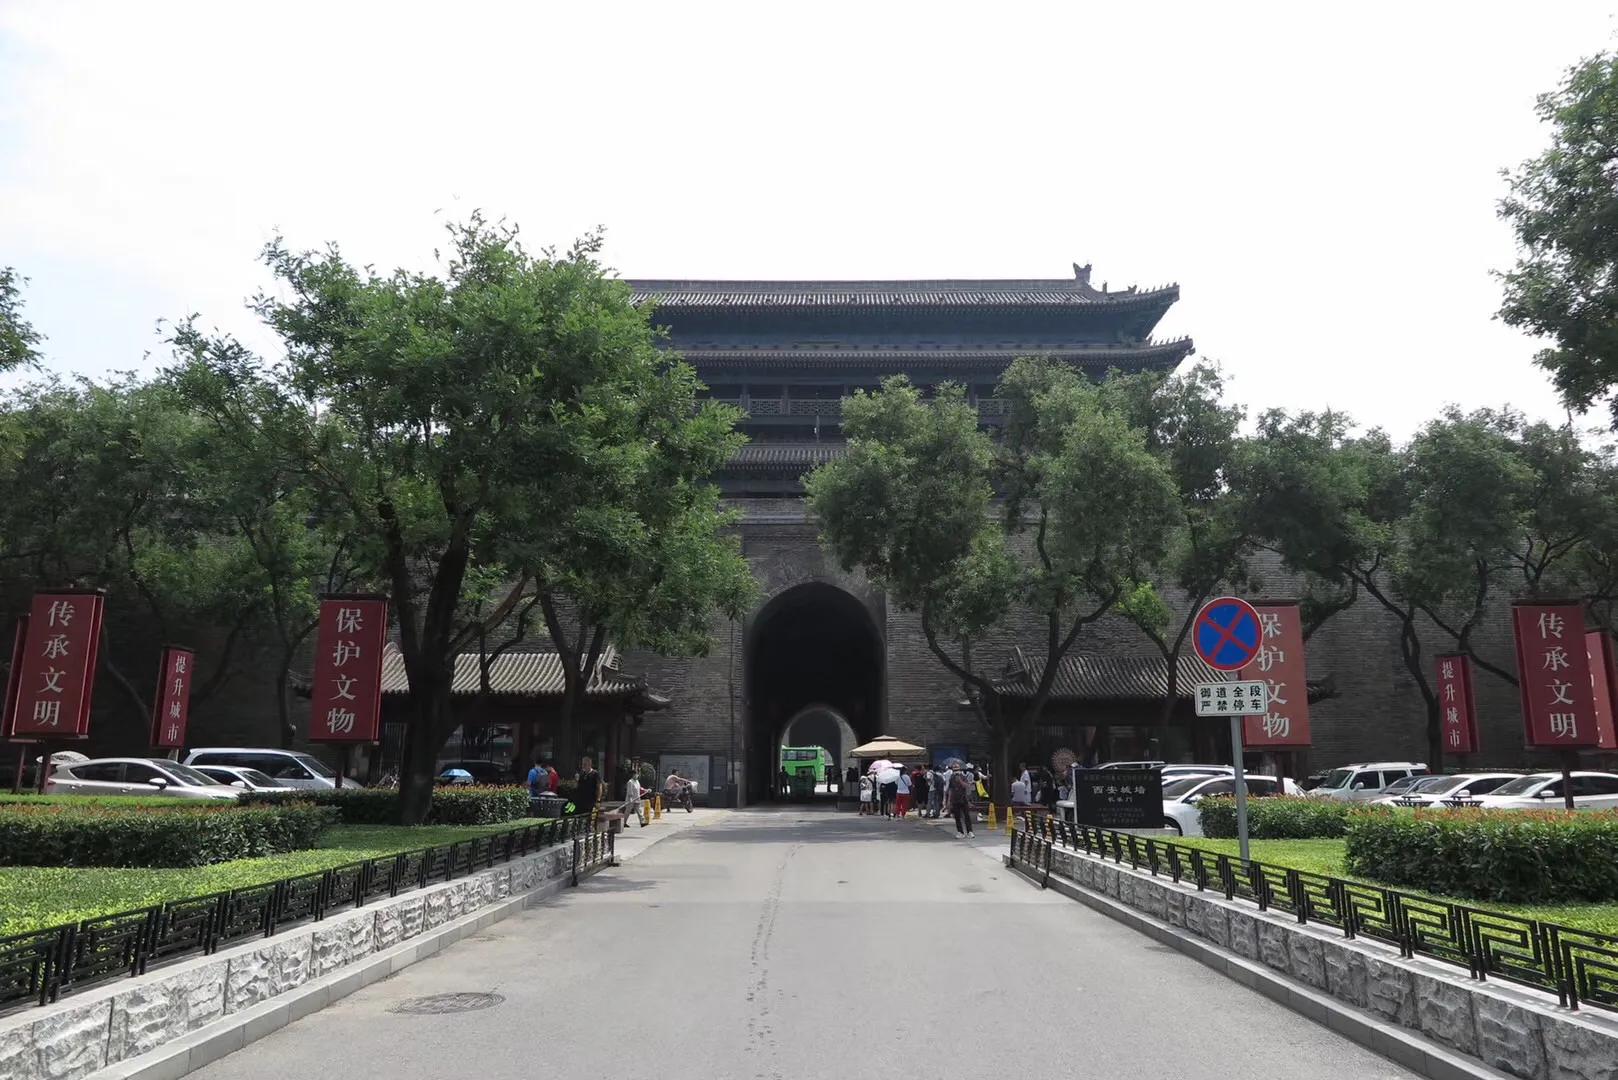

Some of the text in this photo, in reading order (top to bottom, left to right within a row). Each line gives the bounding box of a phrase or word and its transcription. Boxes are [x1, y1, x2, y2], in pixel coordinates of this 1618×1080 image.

[32, 600, 76, 727] 传承文明
[167, 654, 187, 743] 提升城市
[326, 607, 364, 734] 保护文物
[1200, 685, 1262, 699] 御道全段
[1200, 698, 1262, 712] 严禁停车
[1442, 661, 1460, 747] 提升城市
[1537, 612, 1577, 739] 传承文明
[1091, 785, 1146, 795] 西安城墙
